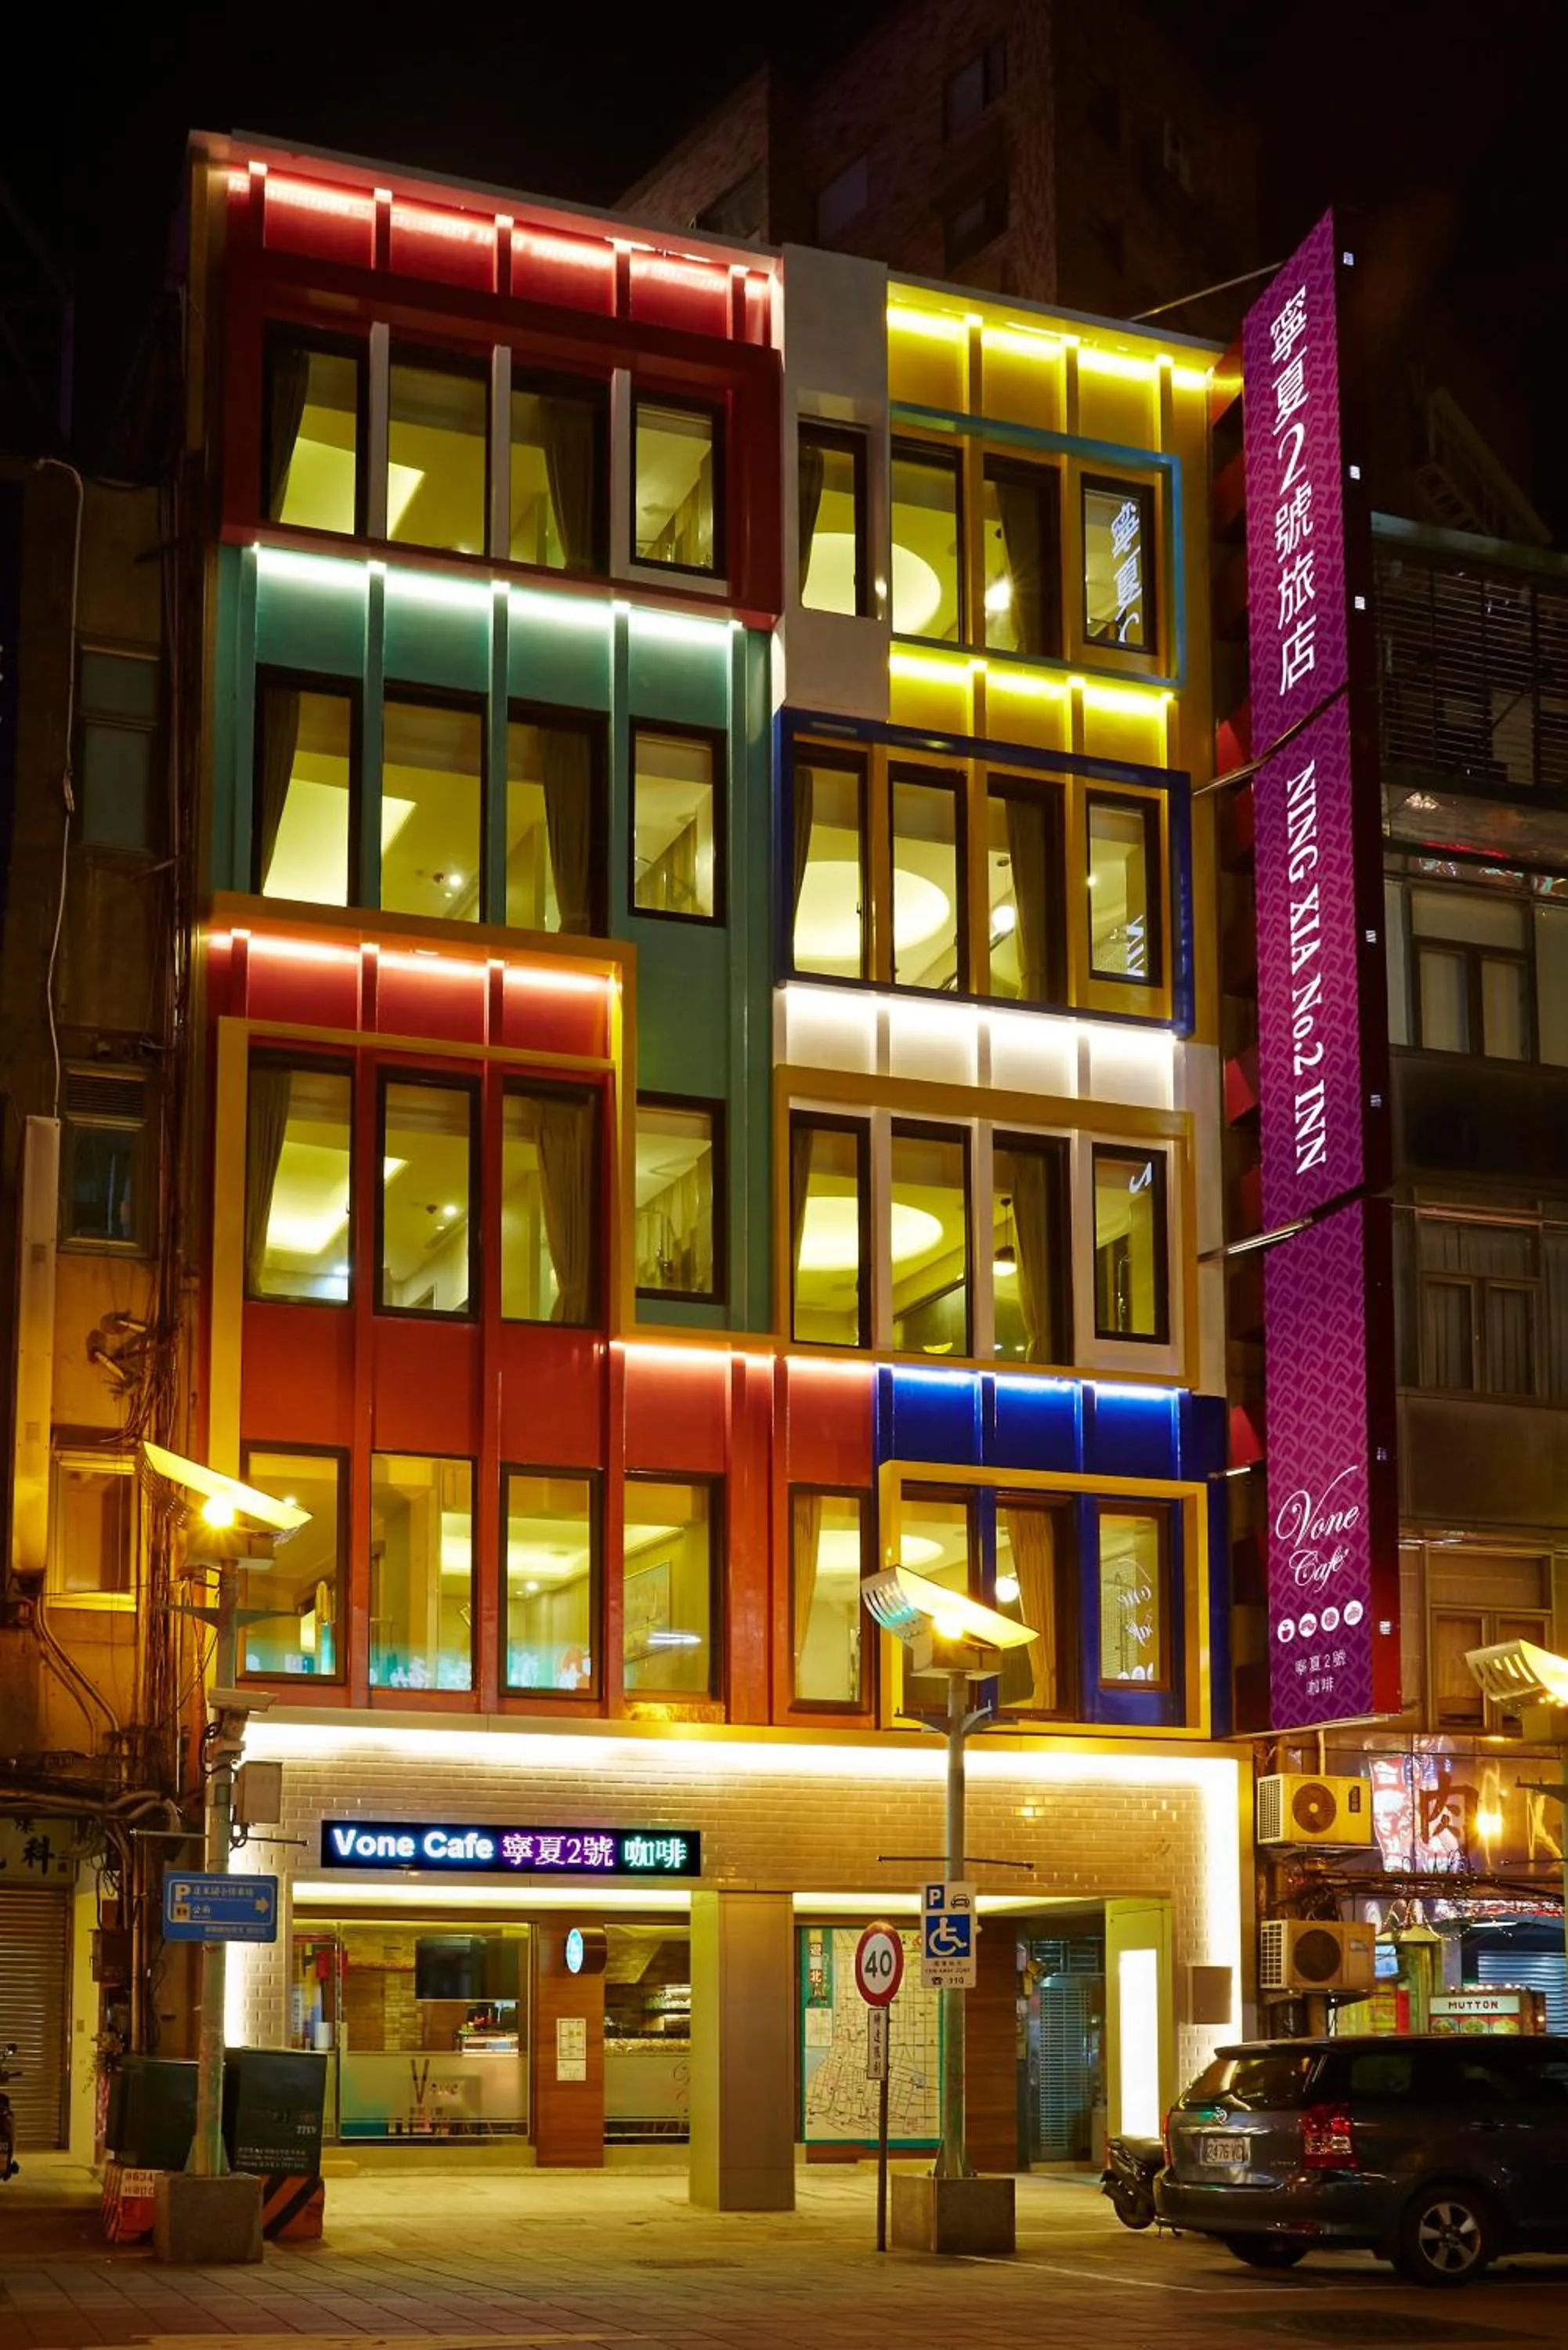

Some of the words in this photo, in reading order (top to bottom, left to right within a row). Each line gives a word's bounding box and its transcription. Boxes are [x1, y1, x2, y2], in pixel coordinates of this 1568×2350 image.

[1270, 284, 1317, 696] 寧夏2號旅店
[1287, 759, 1318, 884] NING
[1290, 882, 1321, 976] XIA
[1292, 971, 1324, 1076] No.2
[1294, 1078, 1327, 1175] INN
[1275, 1465, 1359, 1549] Vone
[333, 1829, 415, 1858] Vone
[423, 1831, 494, 1860] Cafe
[502, 1835, 614, 1867] 寧夏2號
[623, 1837, 687, 1869] 咖啡
[175, 1885, 190, 1901] P
[929, 1889, 941, 1905] P
[865, 1950, 893, 1978] 40
[1449, 2001, 1499, 2009] MUTTON
